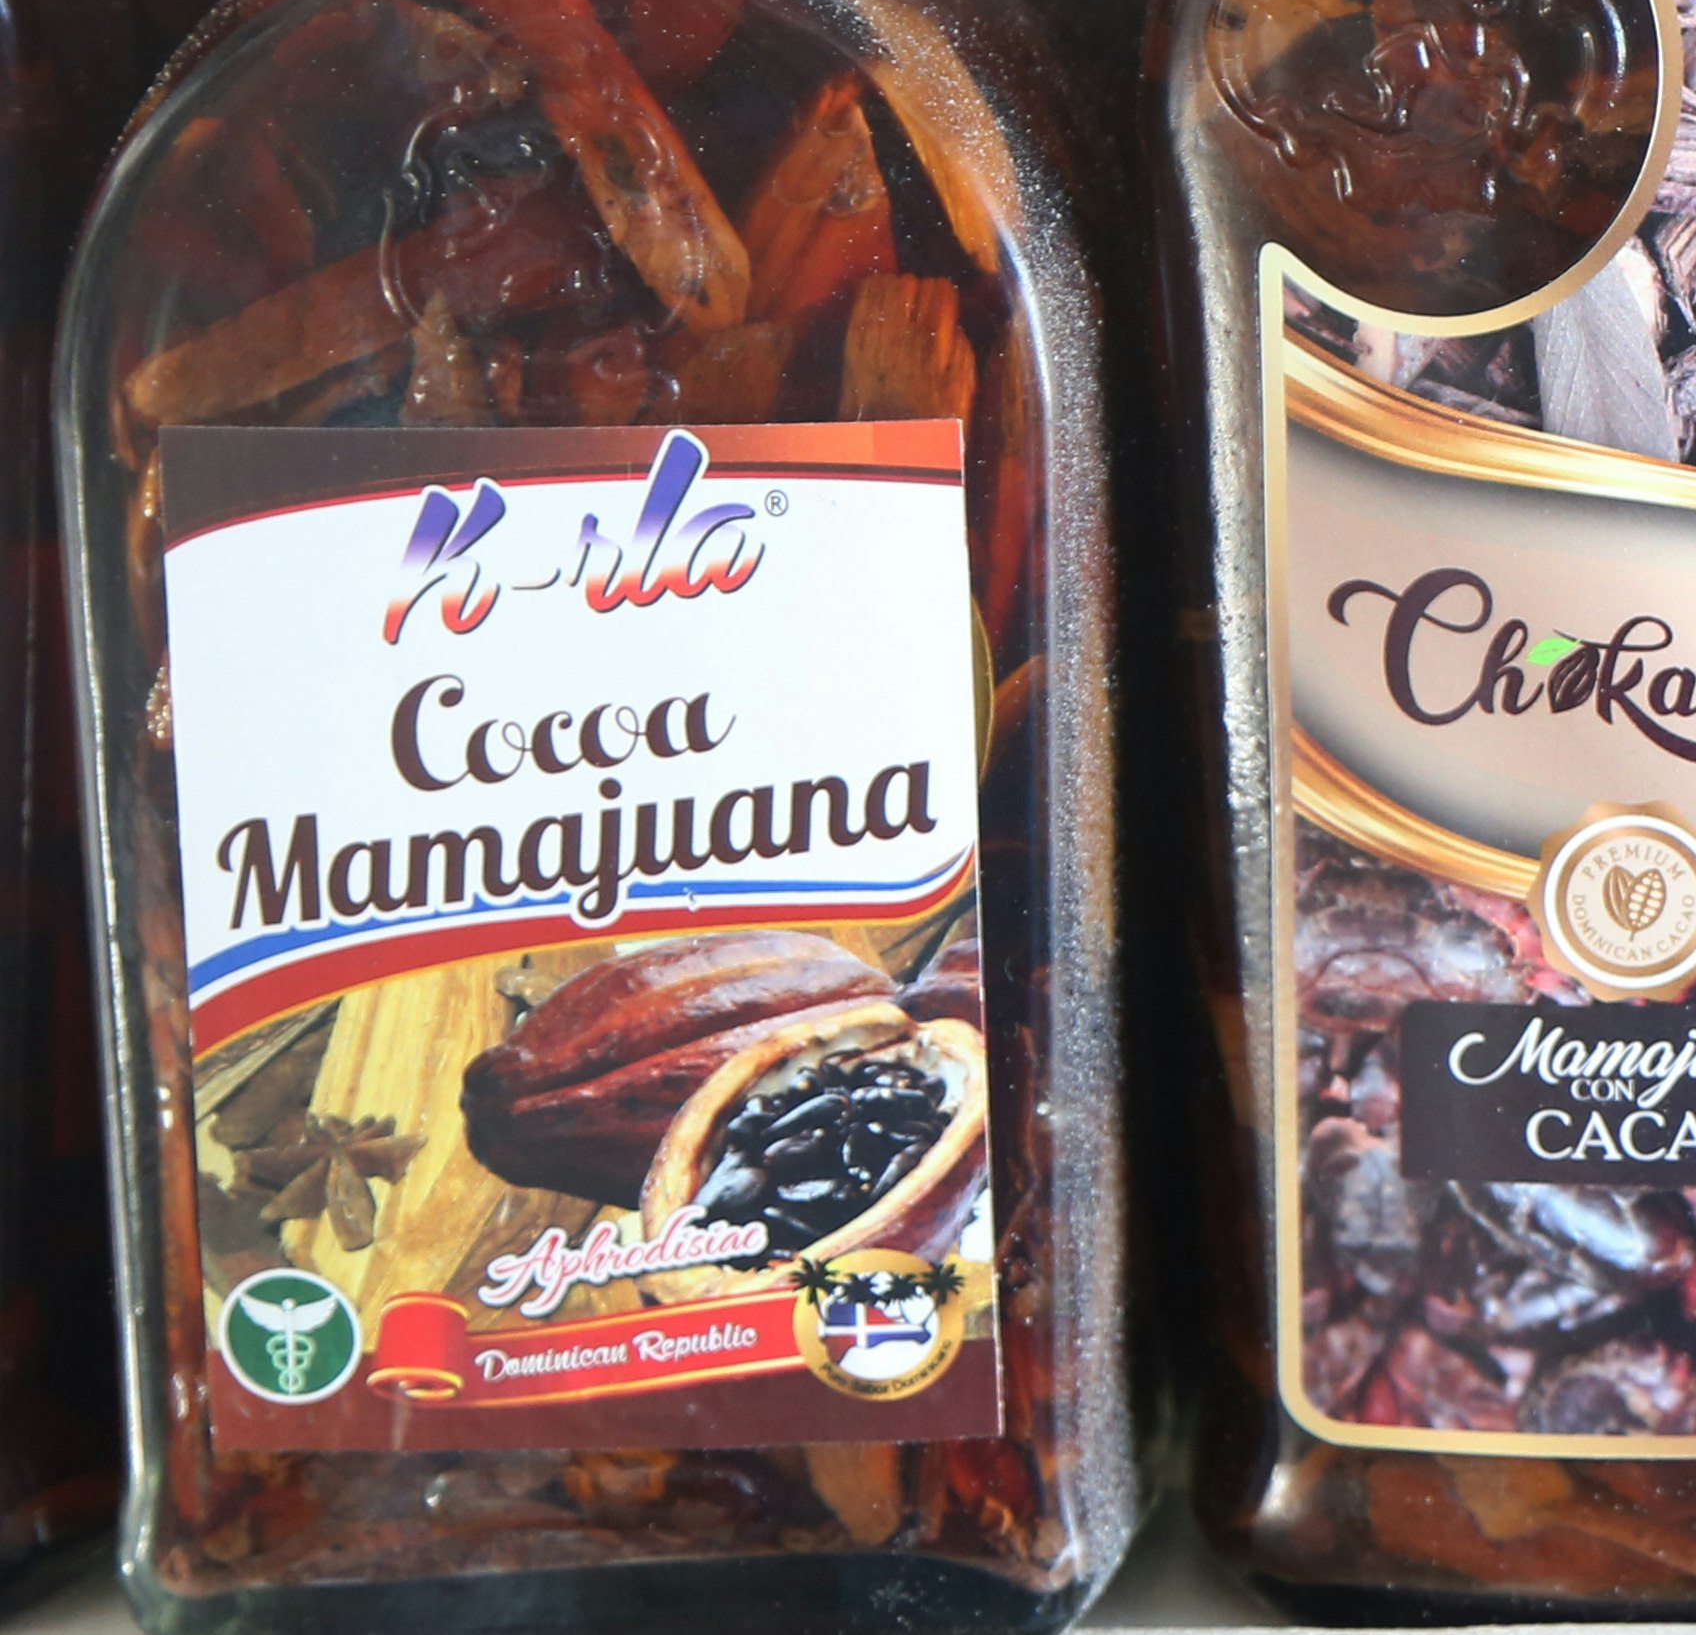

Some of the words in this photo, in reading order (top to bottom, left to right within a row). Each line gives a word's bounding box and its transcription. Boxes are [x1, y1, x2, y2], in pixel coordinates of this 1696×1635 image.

[389, 671, 737, 792] Cocoa
[214, 758, 937, 929] Mamajuana
[1582, 843, 1687, 881] PREMIUM
[1572, 894, 1652, 961] DOMINICAN
[1656, 894, 1695, 954] CACAO
[1570, 1078, 1636, 1103] CON
[480, 1206, 767, 1317] Aphrodisiac
[475, 1340, 628, 1382] Dominican
[632, 1322, 758, 1363] Republic
